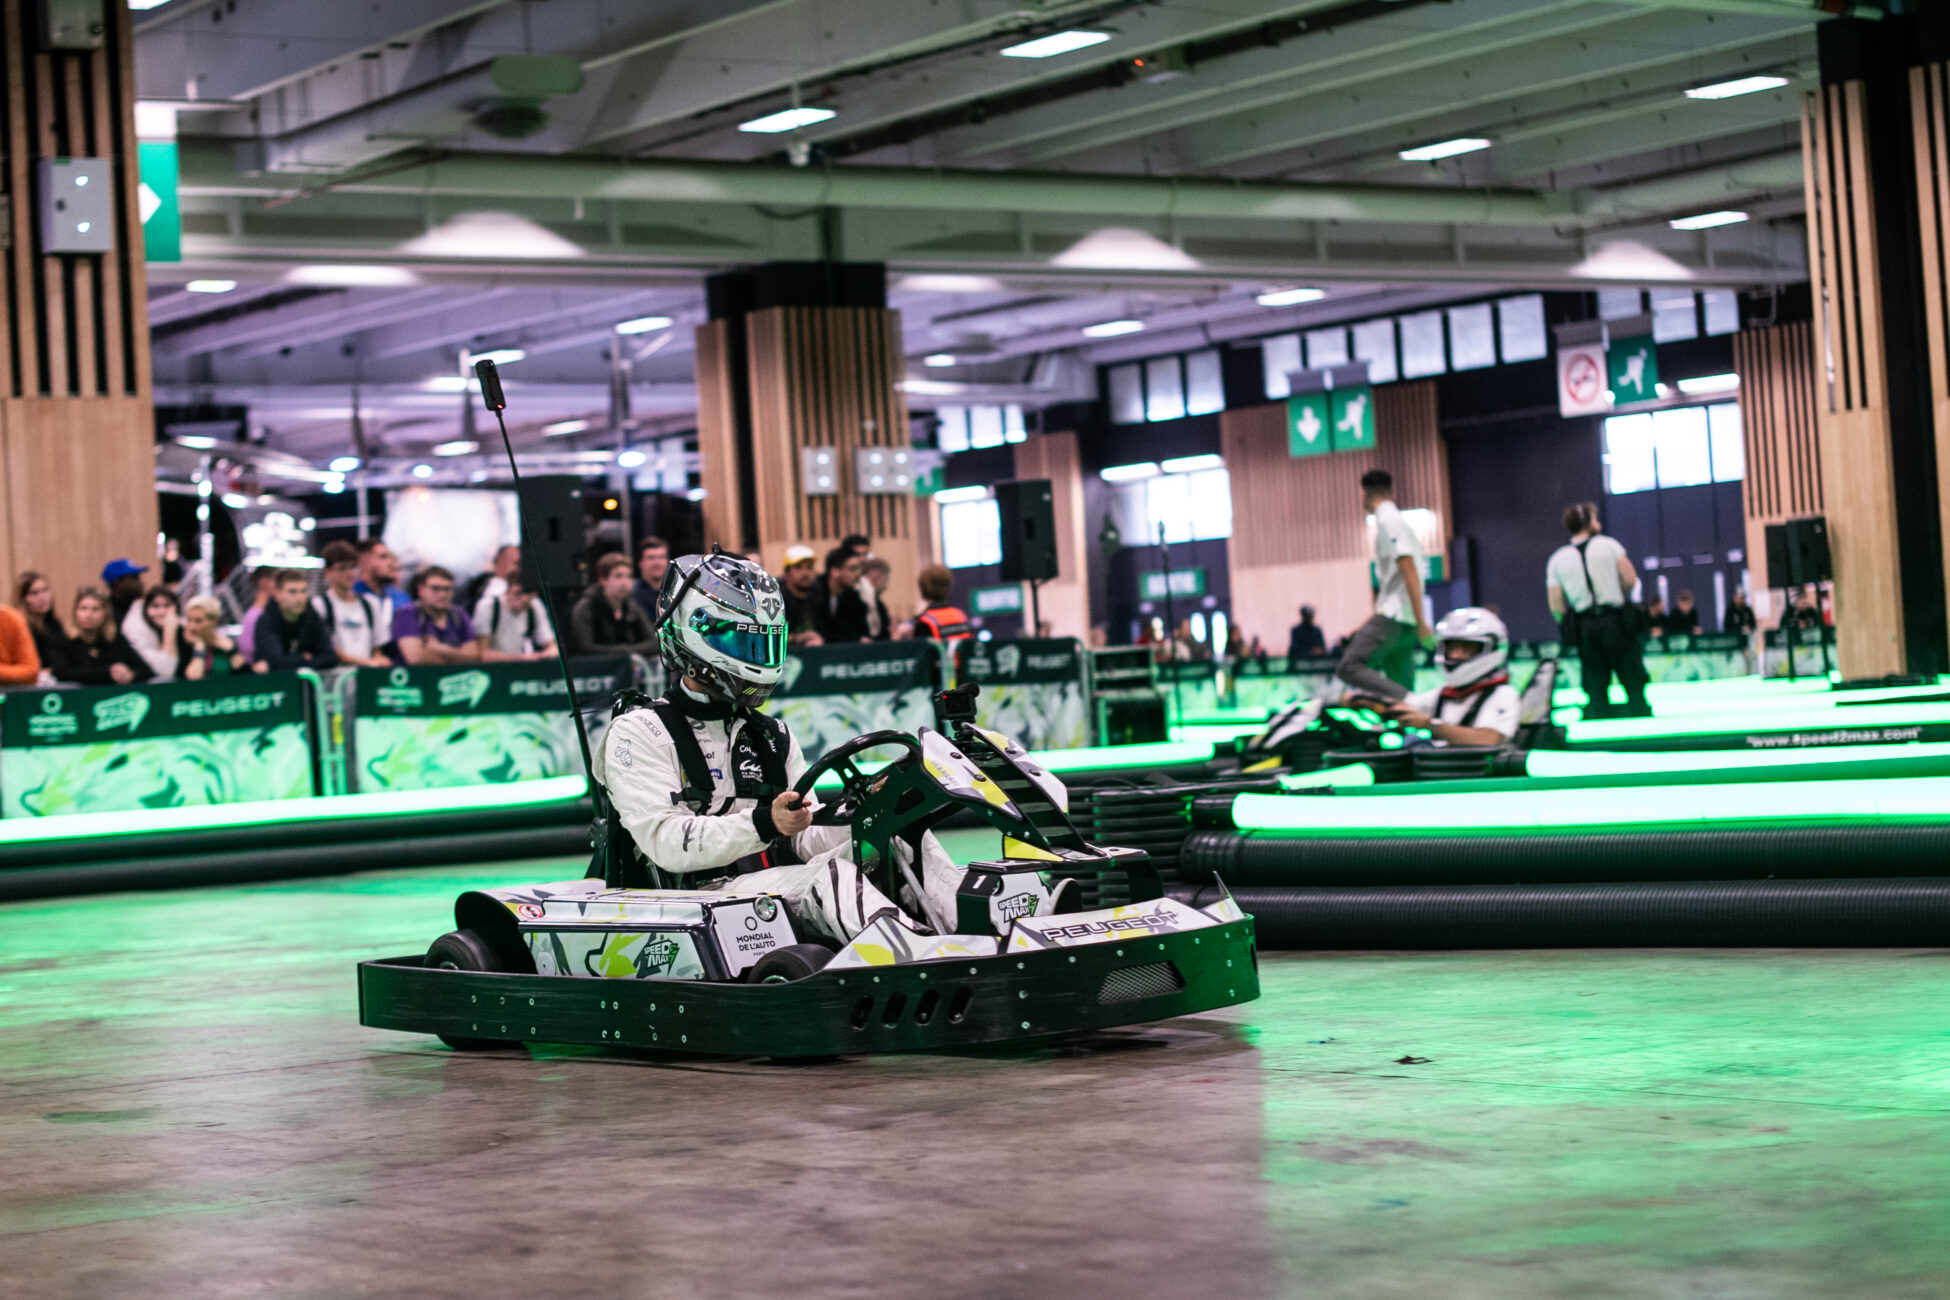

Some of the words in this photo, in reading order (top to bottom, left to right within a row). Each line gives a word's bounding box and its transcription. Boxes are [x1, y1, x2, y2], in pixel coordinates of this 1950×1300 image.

[820, 659, 916, 679] PEUGEOT
[171, 692, 286, 718] PEUGEOT
[972, 875, 987, 889] 1
[1041, 911, 1178, 941] PEUGEOT
[736, 932, 774, 943] MONDIAL
[739, 943, 750, 951] DE
[750, 940, 776, 950] L'AUTO
